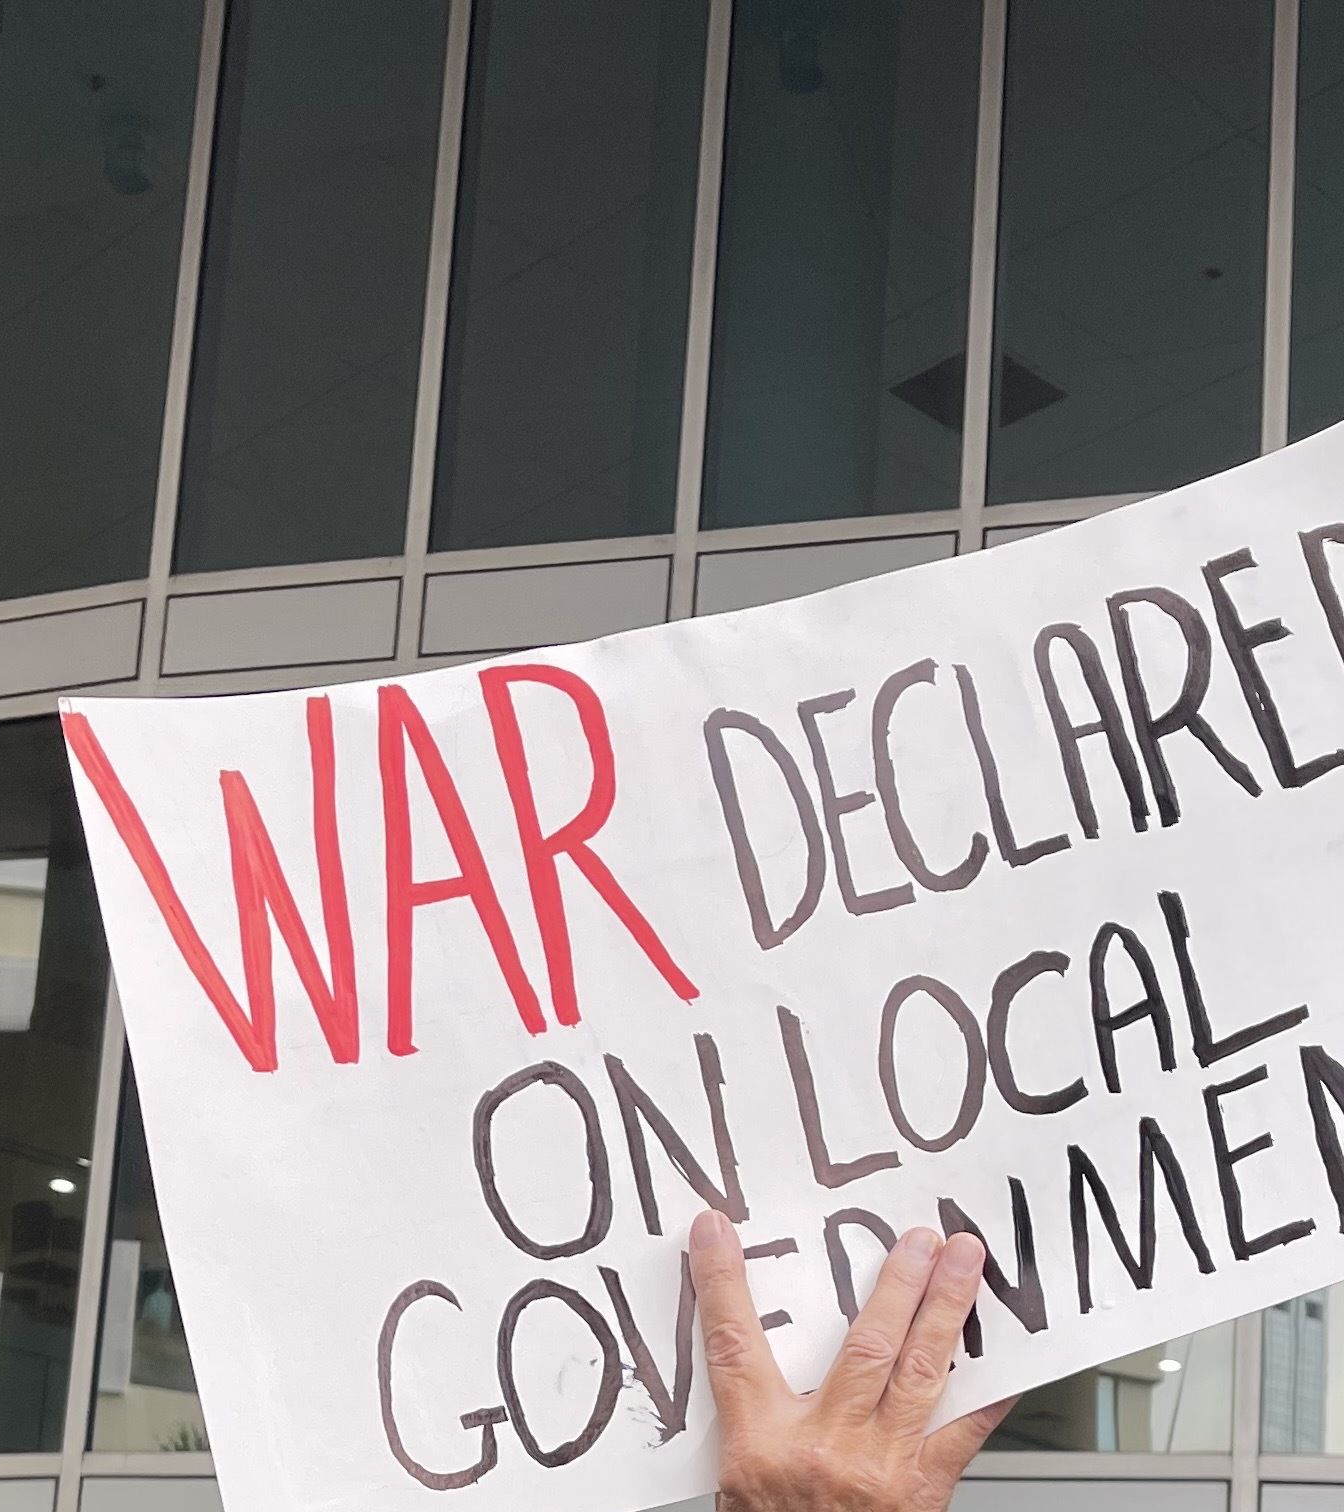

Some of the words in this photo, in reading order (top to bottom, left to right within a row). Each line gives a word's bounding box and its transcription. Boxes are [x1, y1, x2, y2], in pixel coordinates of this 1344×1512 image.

[61, 663, 698, 1073] WAR
[473, 1033, 750, 1257] ON
[779, 891, 1307, 1190] LOCAL
